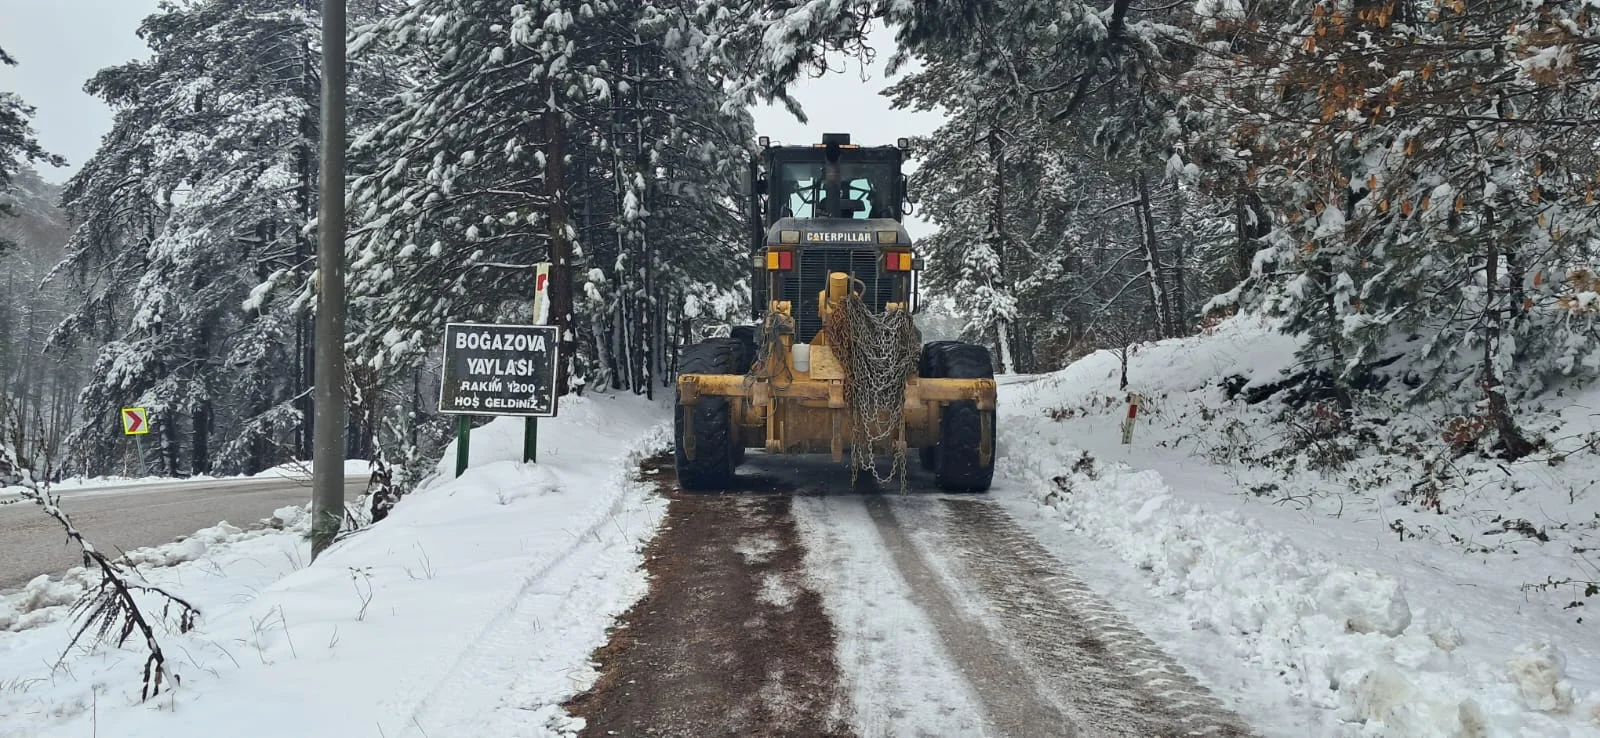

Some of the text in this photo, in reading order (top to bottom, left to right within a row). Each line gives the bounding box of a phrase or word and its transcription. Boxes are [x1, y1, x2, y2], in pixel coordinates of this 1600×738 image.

[807, 232, 871, 242] CATERPILLAR
[455, 331, 546, 352] BOĞAZOVA
[467, 358, 533, 376] YAYLASI
[460, 380, 536, 393] RAKIM 1200
[454, 396, 480, 408] HOŞ
